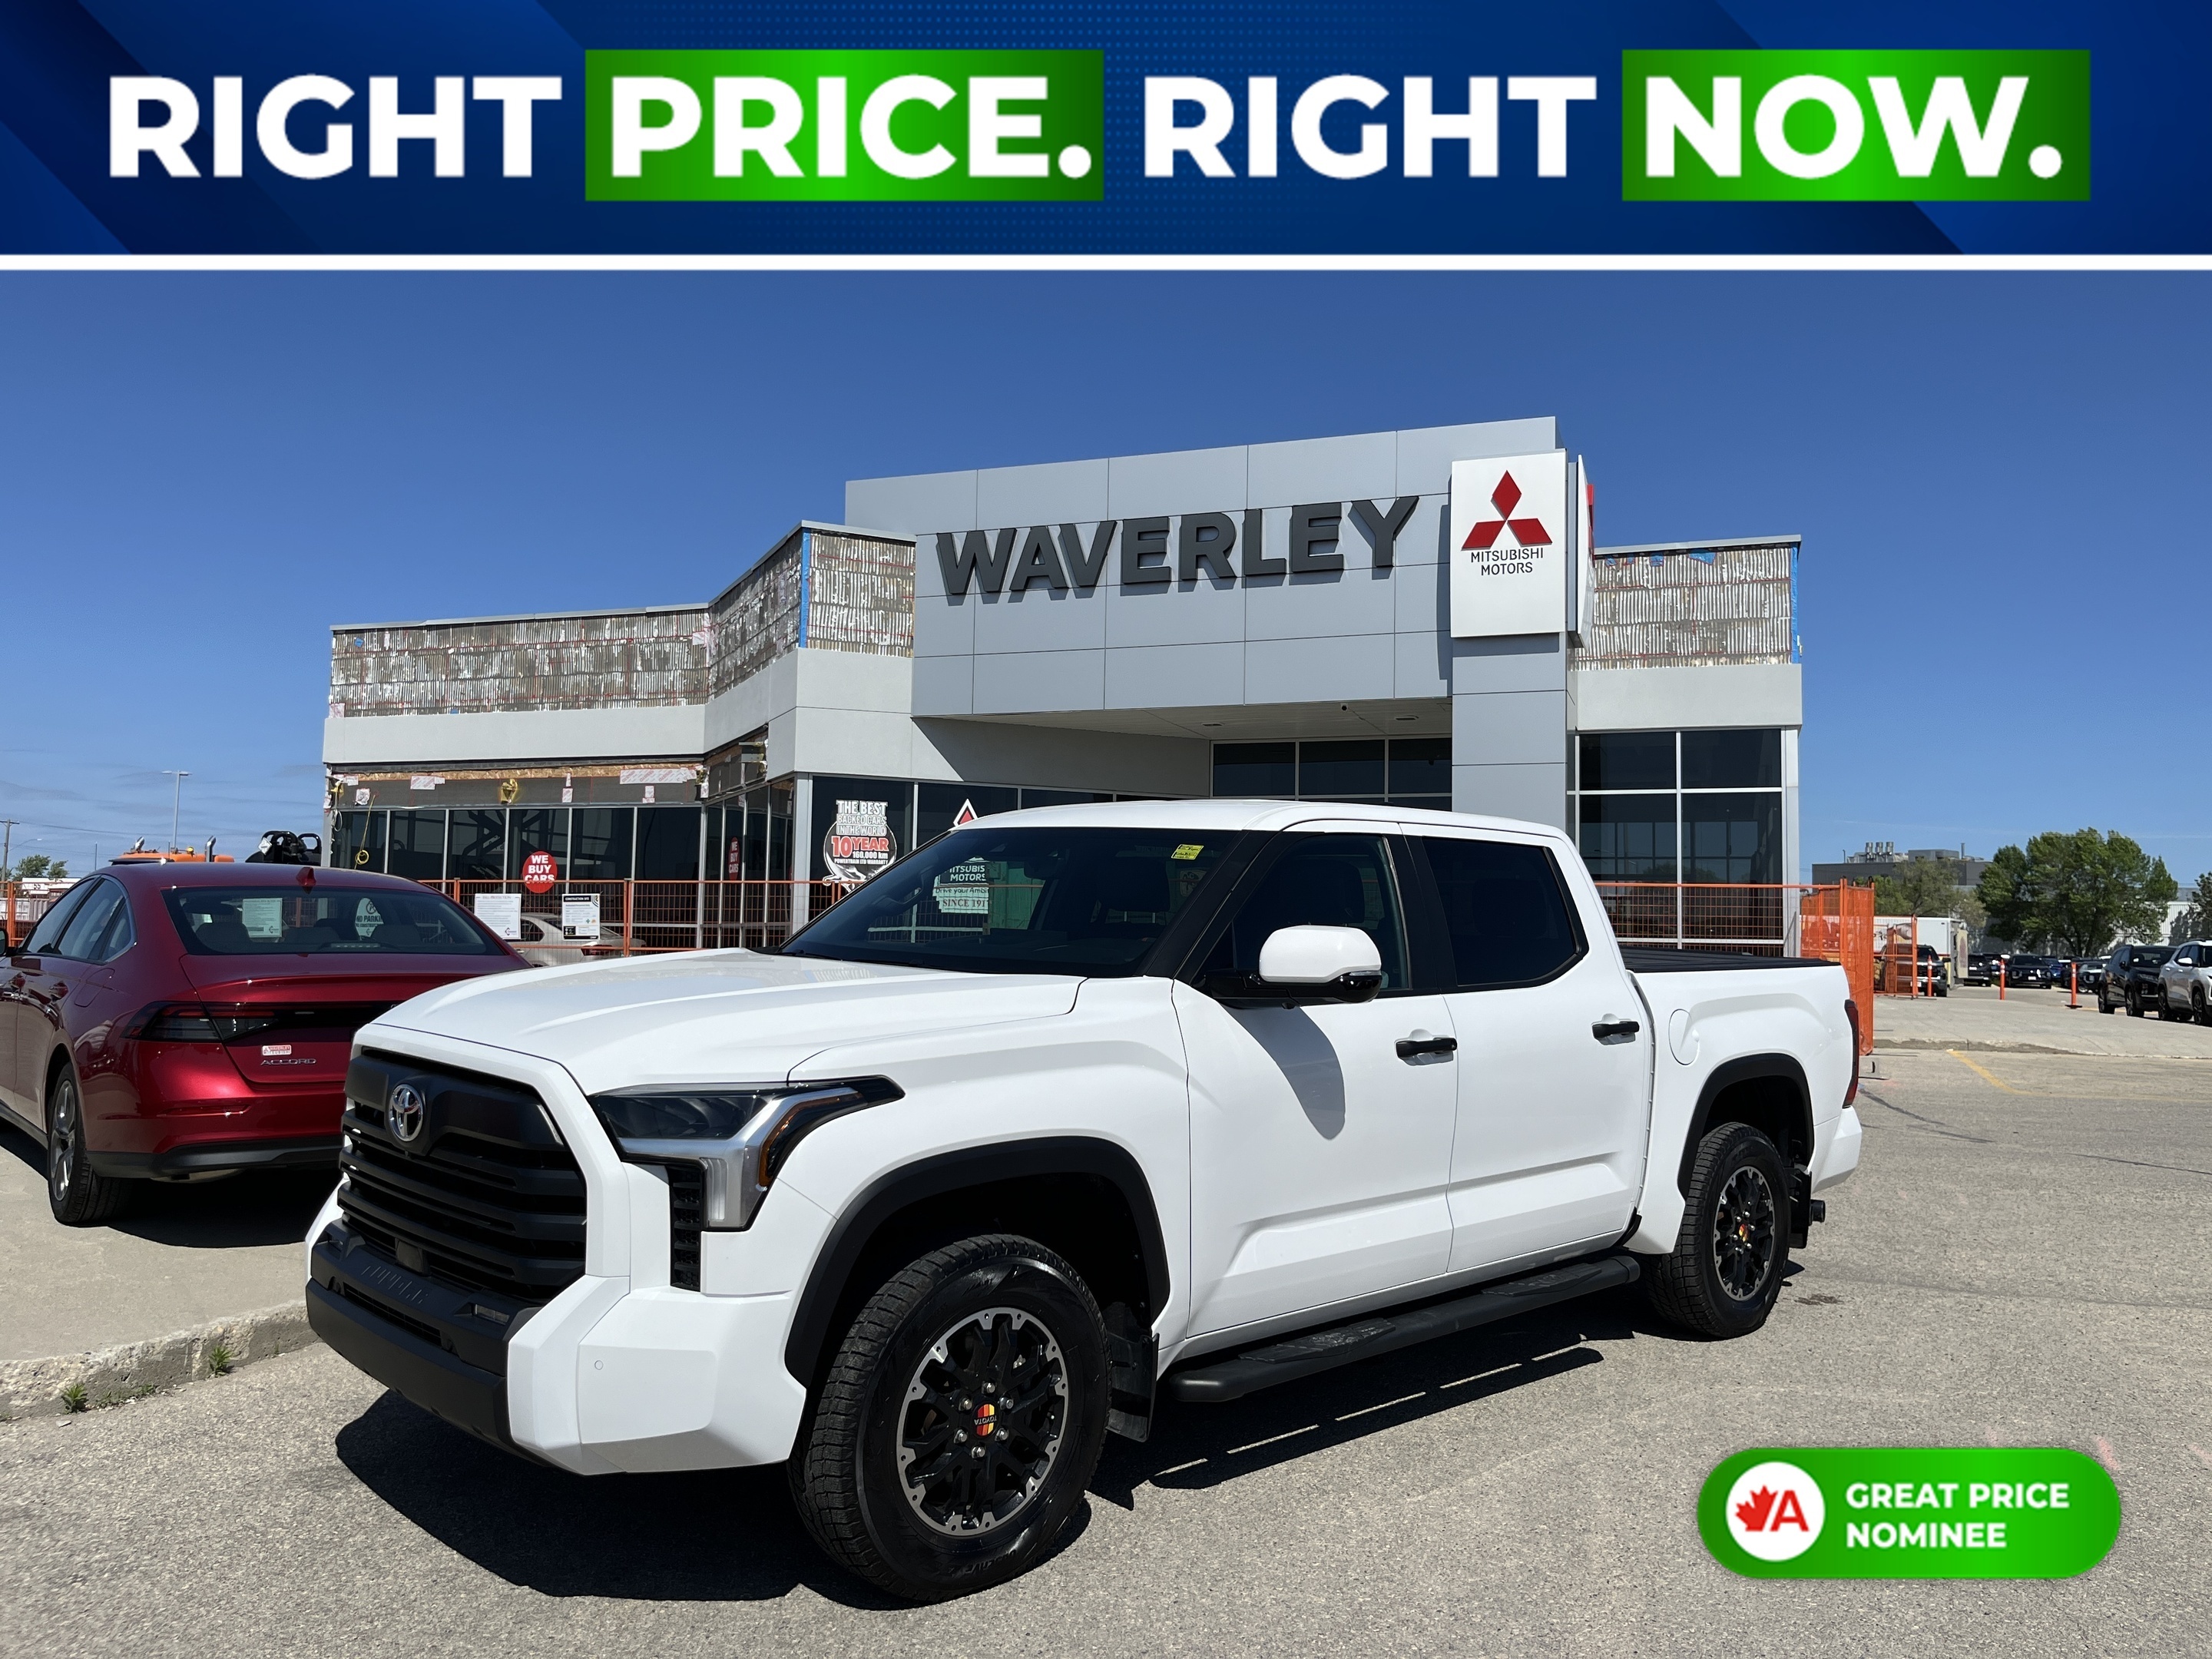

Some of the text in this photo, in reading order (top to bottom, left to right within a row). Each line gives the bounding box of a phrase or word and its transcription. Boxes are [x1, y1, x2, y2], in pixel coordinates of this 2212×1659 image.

[935, 495, 1419, 595] WAVERLEY
[1471, 547, 1544, 563] MITSUBISHI
[1481, 561, 1533, 576] MOTORS
[836, 800, 888, 815] THE BEST
[838, 814, 887, 825] BACKED CARS
[838, 825, 886, 836] IN THE WORLD
[832, 836, 889, 857] 10 YEAR
[531, 855, 549, 864] WE
[878, 851, 889, 859] km
[528, 865, 551, 874] BUY
[525, 874, 555, 883] CARS
[942, 899, 969, 907] SINCE
[974, 1415, 998, 1426] TOYOTA
